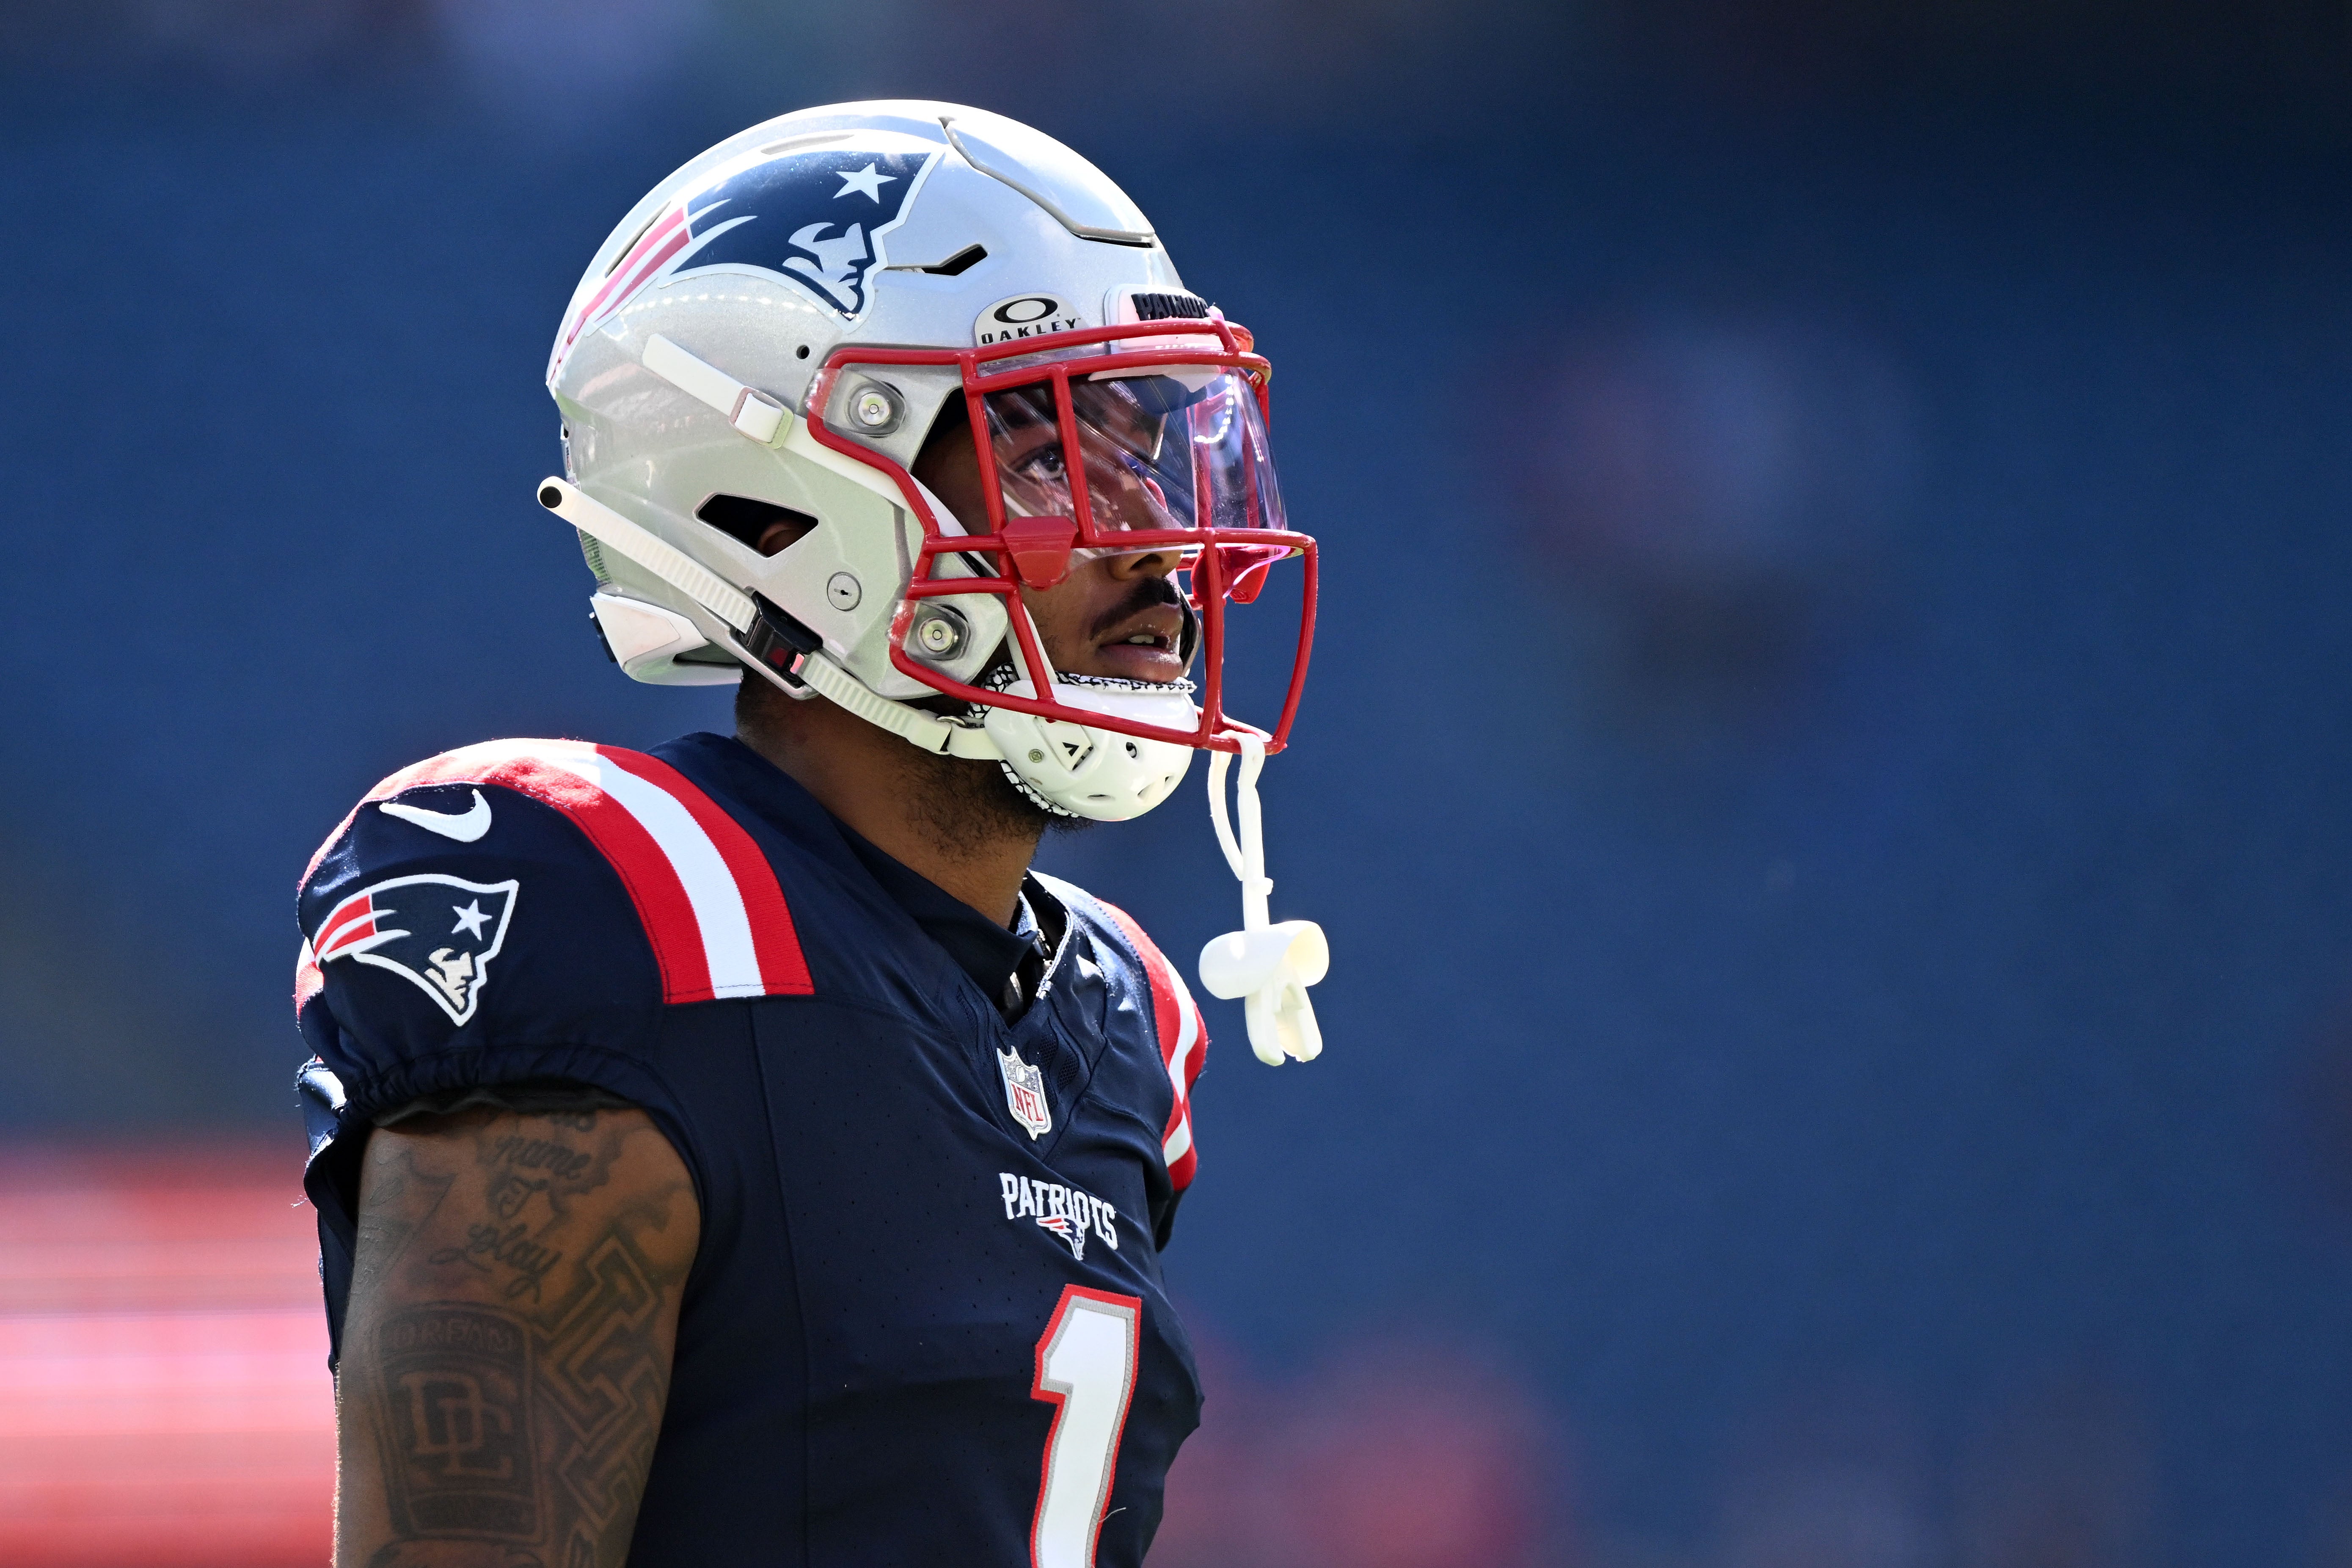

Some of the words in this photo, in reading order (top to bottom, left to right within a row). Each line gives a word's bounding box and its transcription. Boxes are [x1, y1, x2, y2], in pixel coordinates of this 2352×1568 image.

[981, 318, 1076, 344] OAKLEY
[1011, 1083, 1044, 1122] NFL
[999, 1172, 1118, 1251] PATRIOTS
[1029, 1283, 1142, 1568] 1
